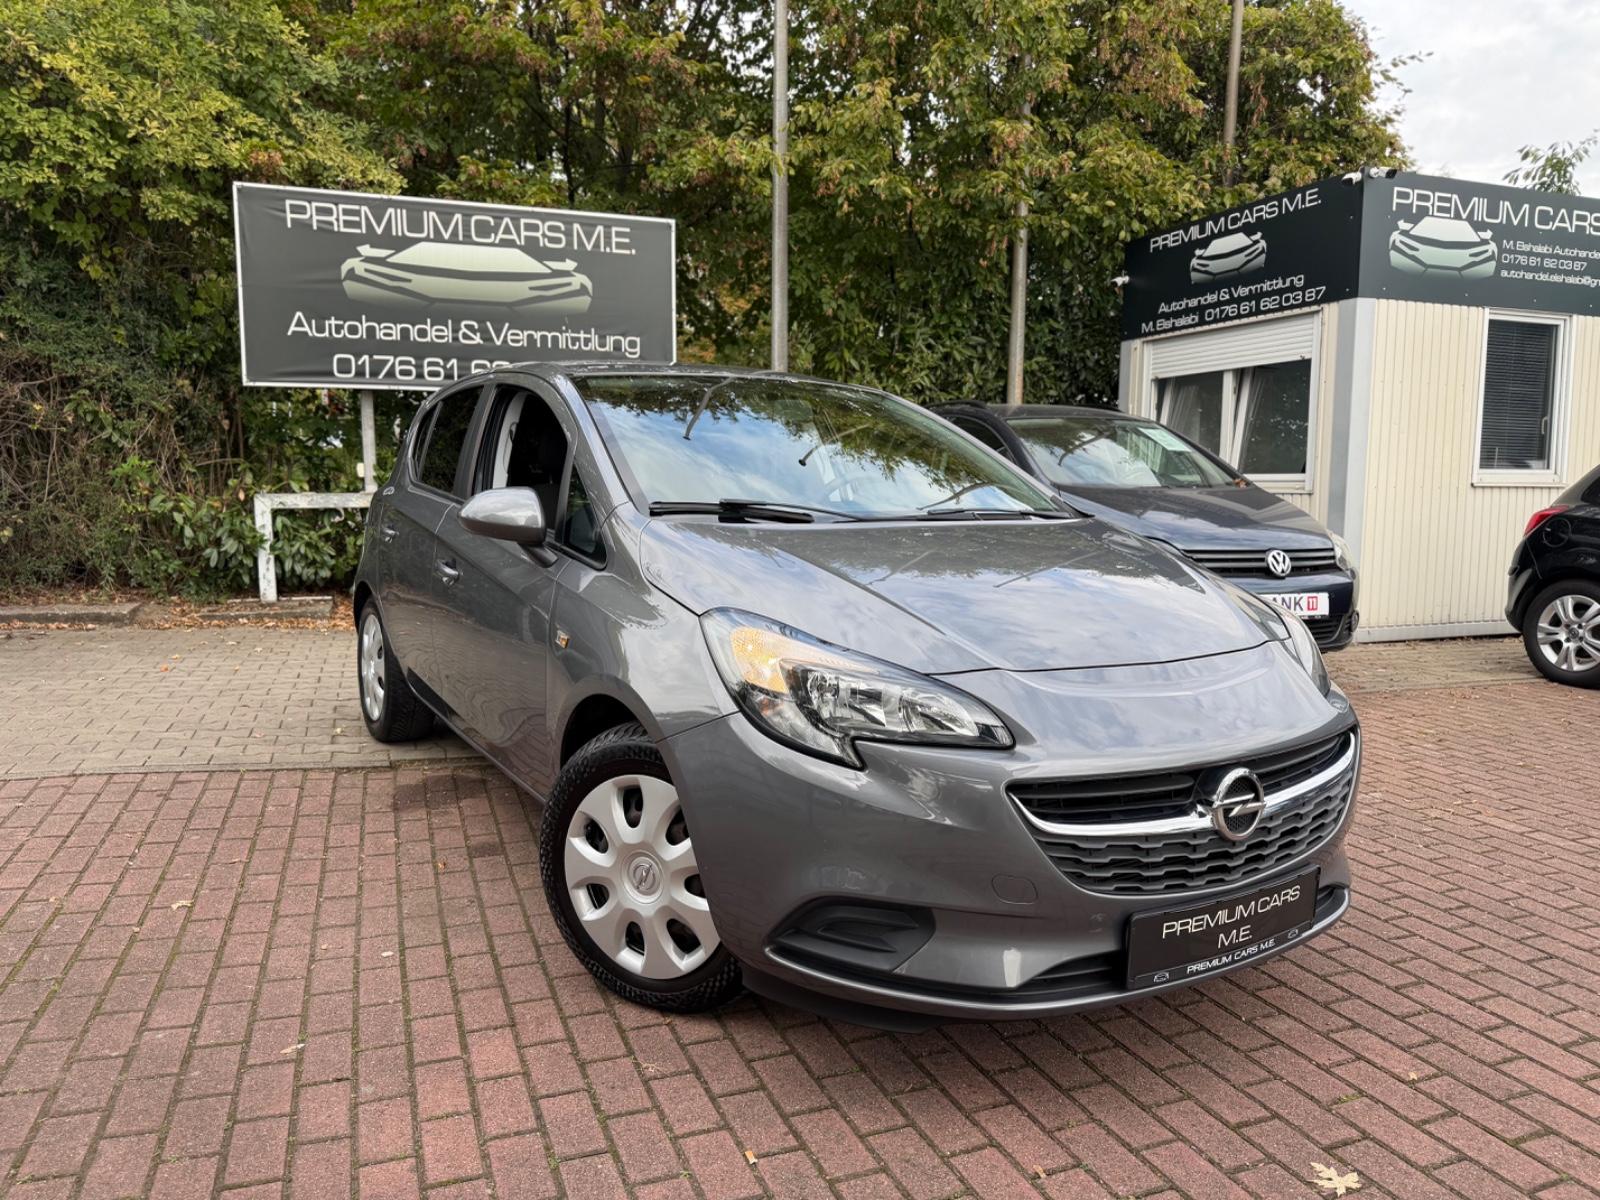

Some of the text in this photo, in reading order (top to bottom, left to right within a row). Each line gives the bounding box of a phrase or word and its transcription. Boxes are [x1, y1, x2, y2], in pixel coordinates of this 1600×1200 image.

[1150, 188, 1322, 253] PREMIUM CARS M.E.
[1392, 186, 1529, 227] PREMIUM
[285, 199, 636, 255] PREMIUM CARS M.E.
[1501, 253, 1587, 271] 0176 61 62 03 87
[1502, 240, 1514, 250] M.
[1553, 245, 1600, 260] Autohande
[1141, 322, 1154, 333] M.
[1204, 305, 1238, 321] 0176
[1239, 301, 1256, 315] 61
[1260, 296, 1280, 311] 62
[1282, 291, 1302, 307] 03
[1305, 286, 1326, 301] 87
[1158, 274, 1305, 314] Autohandel & Vermittlung
[287, 311, 641, 358] Autohandel & Vermittlung
[333, 353, 416, 381] 0176
[423, 357, 458, 381] 61
[1268, 550, 1291, 576] VW
[1162, 885, 1300, 939] PREMIUM CARS
[1218, 925, 1253, 949] M.E.
[1186, 955, 1232, 974] PREMIUM
[1234, 945, 1258, 960] CARS
